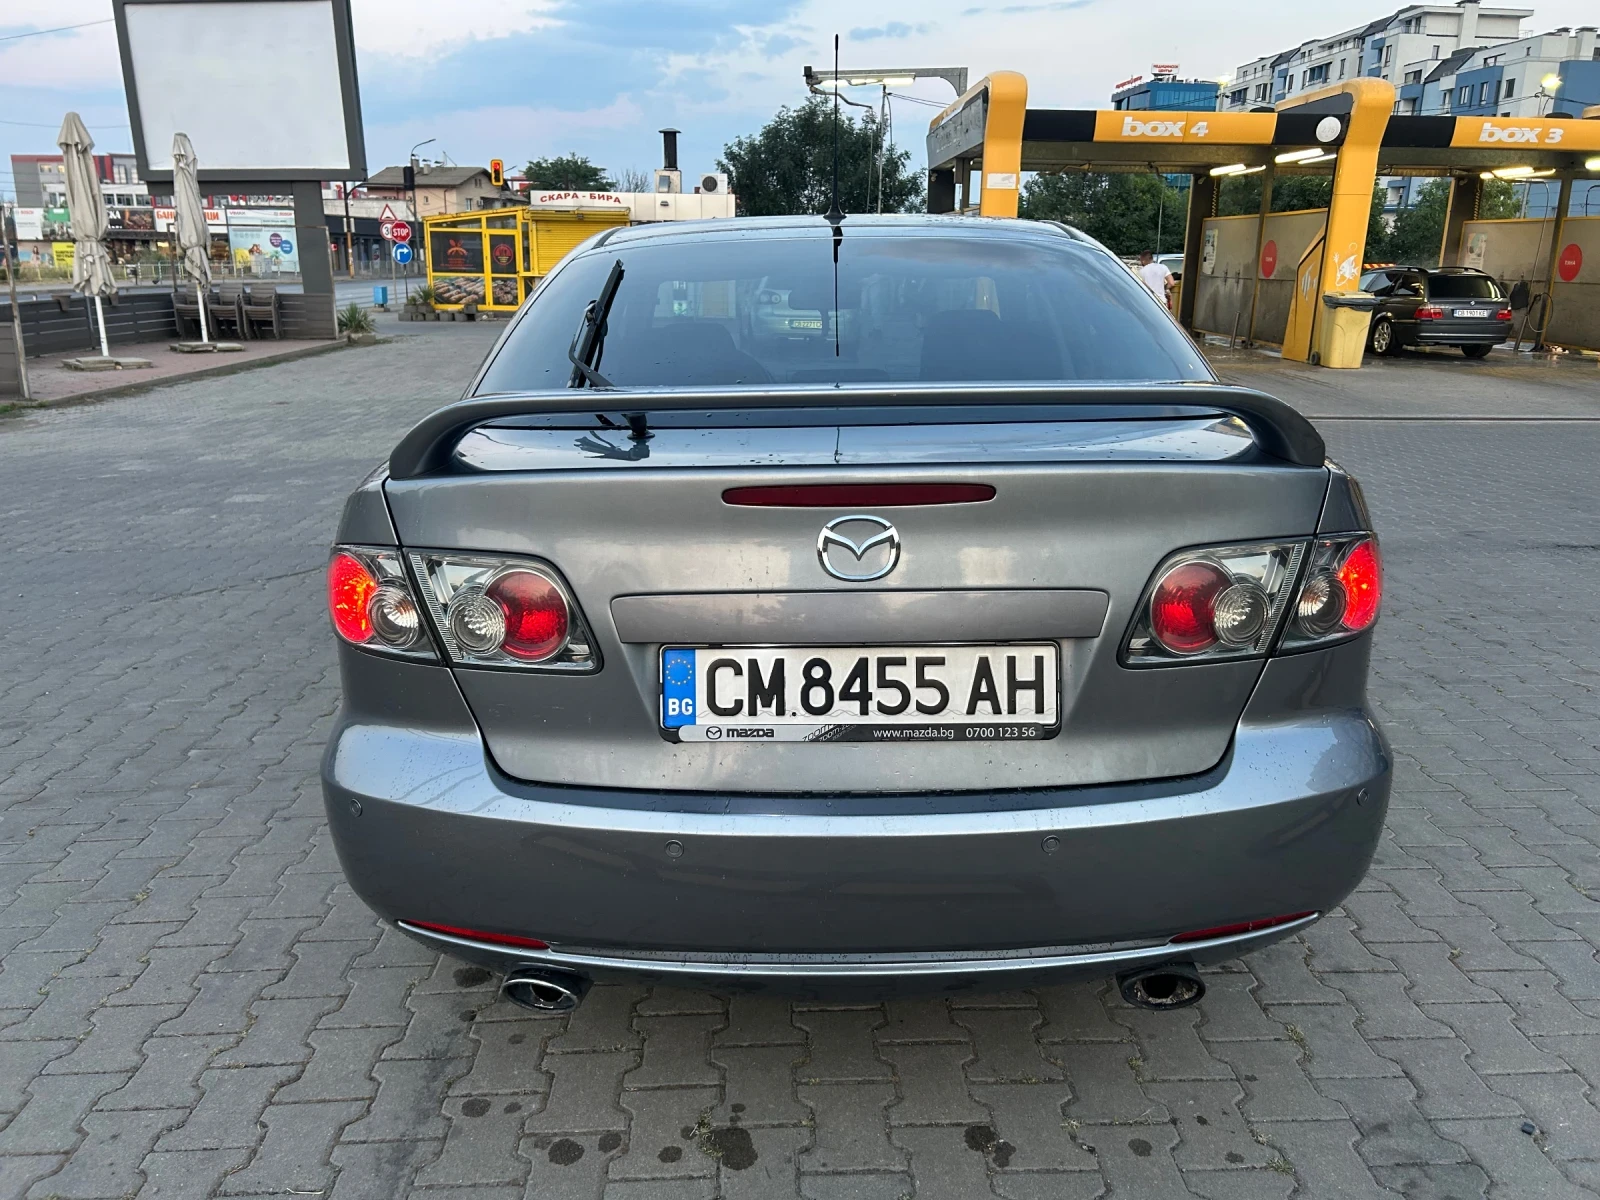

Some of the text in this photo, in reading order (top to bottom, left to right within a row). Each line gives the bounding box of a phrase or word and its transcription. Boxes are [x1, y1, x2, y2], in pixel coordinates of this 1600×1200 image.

[1121, 116, 1209, 137] box 4
[1479, 122, 1564, 143] box 3
[540, 192, 579, 203] СКАРА
[589, 192, 621, 204] БИРА
[392, 228, 409, 237] STOP
[706, 655, 1045, 717] CM 8455 AH
[668, 697, 693, 716] BG
[873, 727, 1036, 740] www.mazda.bg 0700 123 56
